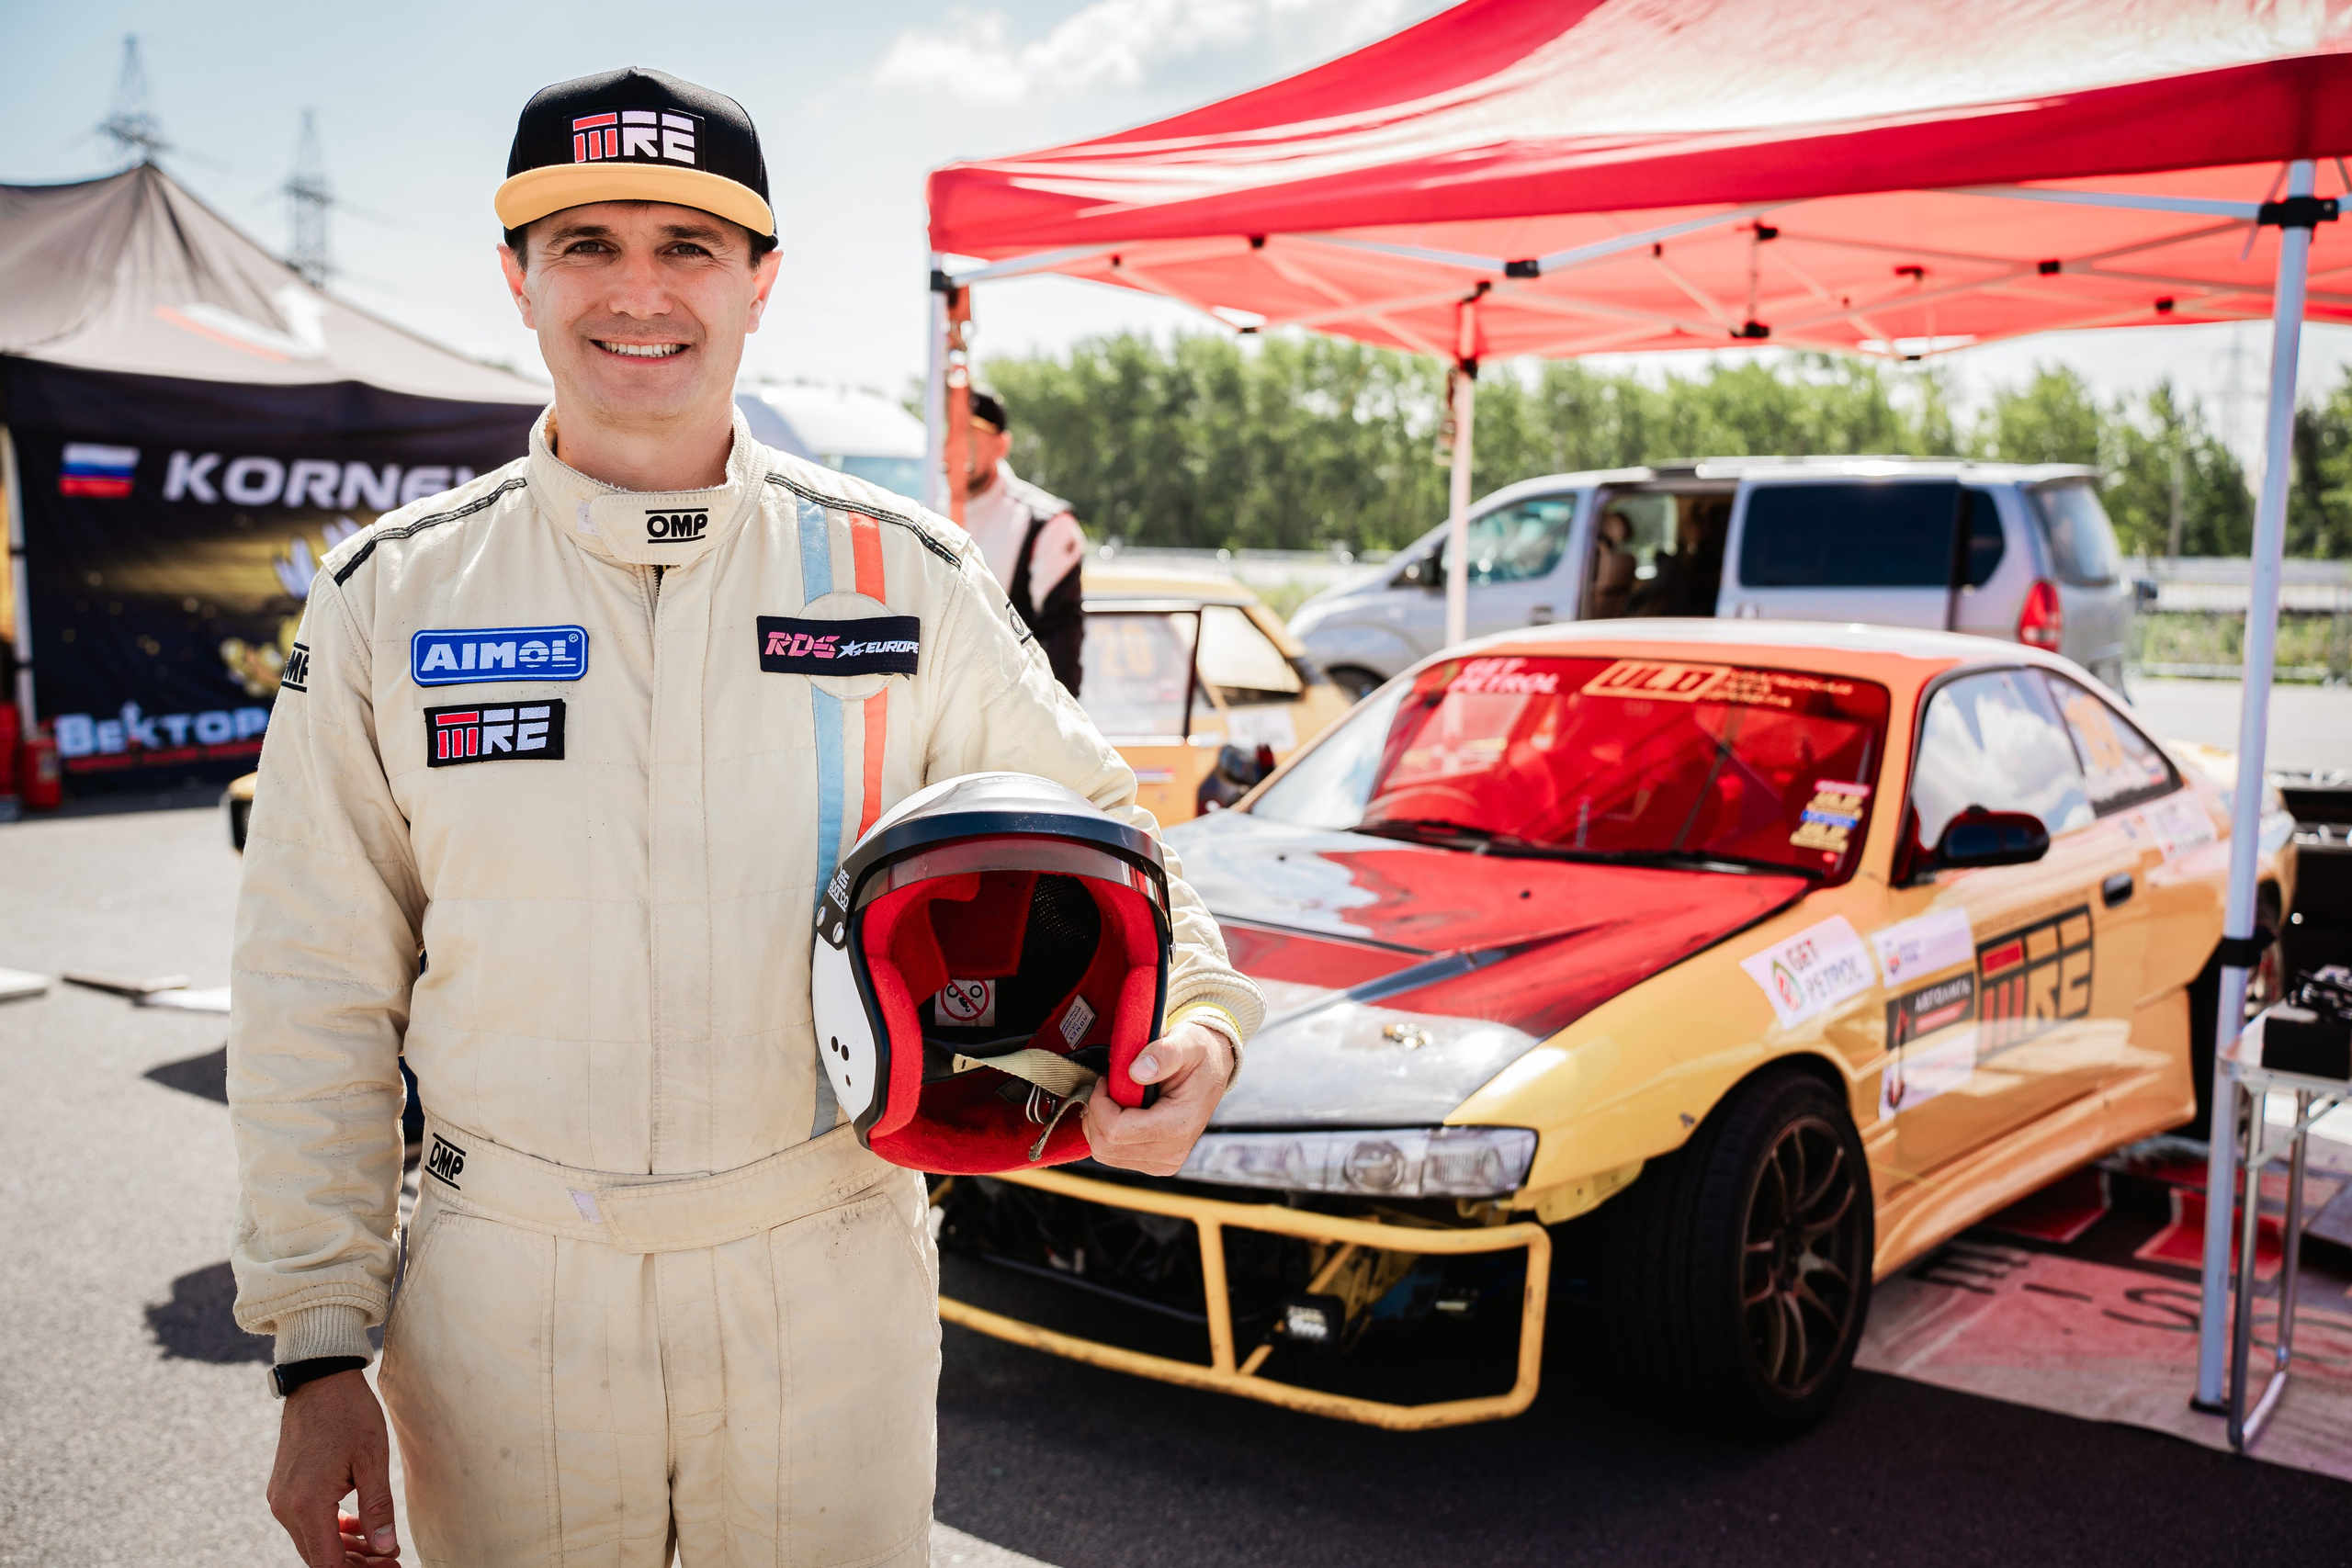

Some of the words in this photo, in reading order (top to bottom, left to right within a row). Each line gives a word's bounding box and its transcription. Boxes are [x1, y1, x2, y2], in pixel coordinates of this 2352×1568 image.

[163, 450, 476, 512] KORNE
[646, 513, 708, 538] OMP
[420, 640, 577, 671] AIMOL
[764, 631, 841, 659] RDS
[284, 649, 310, 684] MP
[1786, 938, 1819, 972] GET
[1804, 955, 1864, 1001] PETROL
[429, 1141, 465, 1181] OMP
